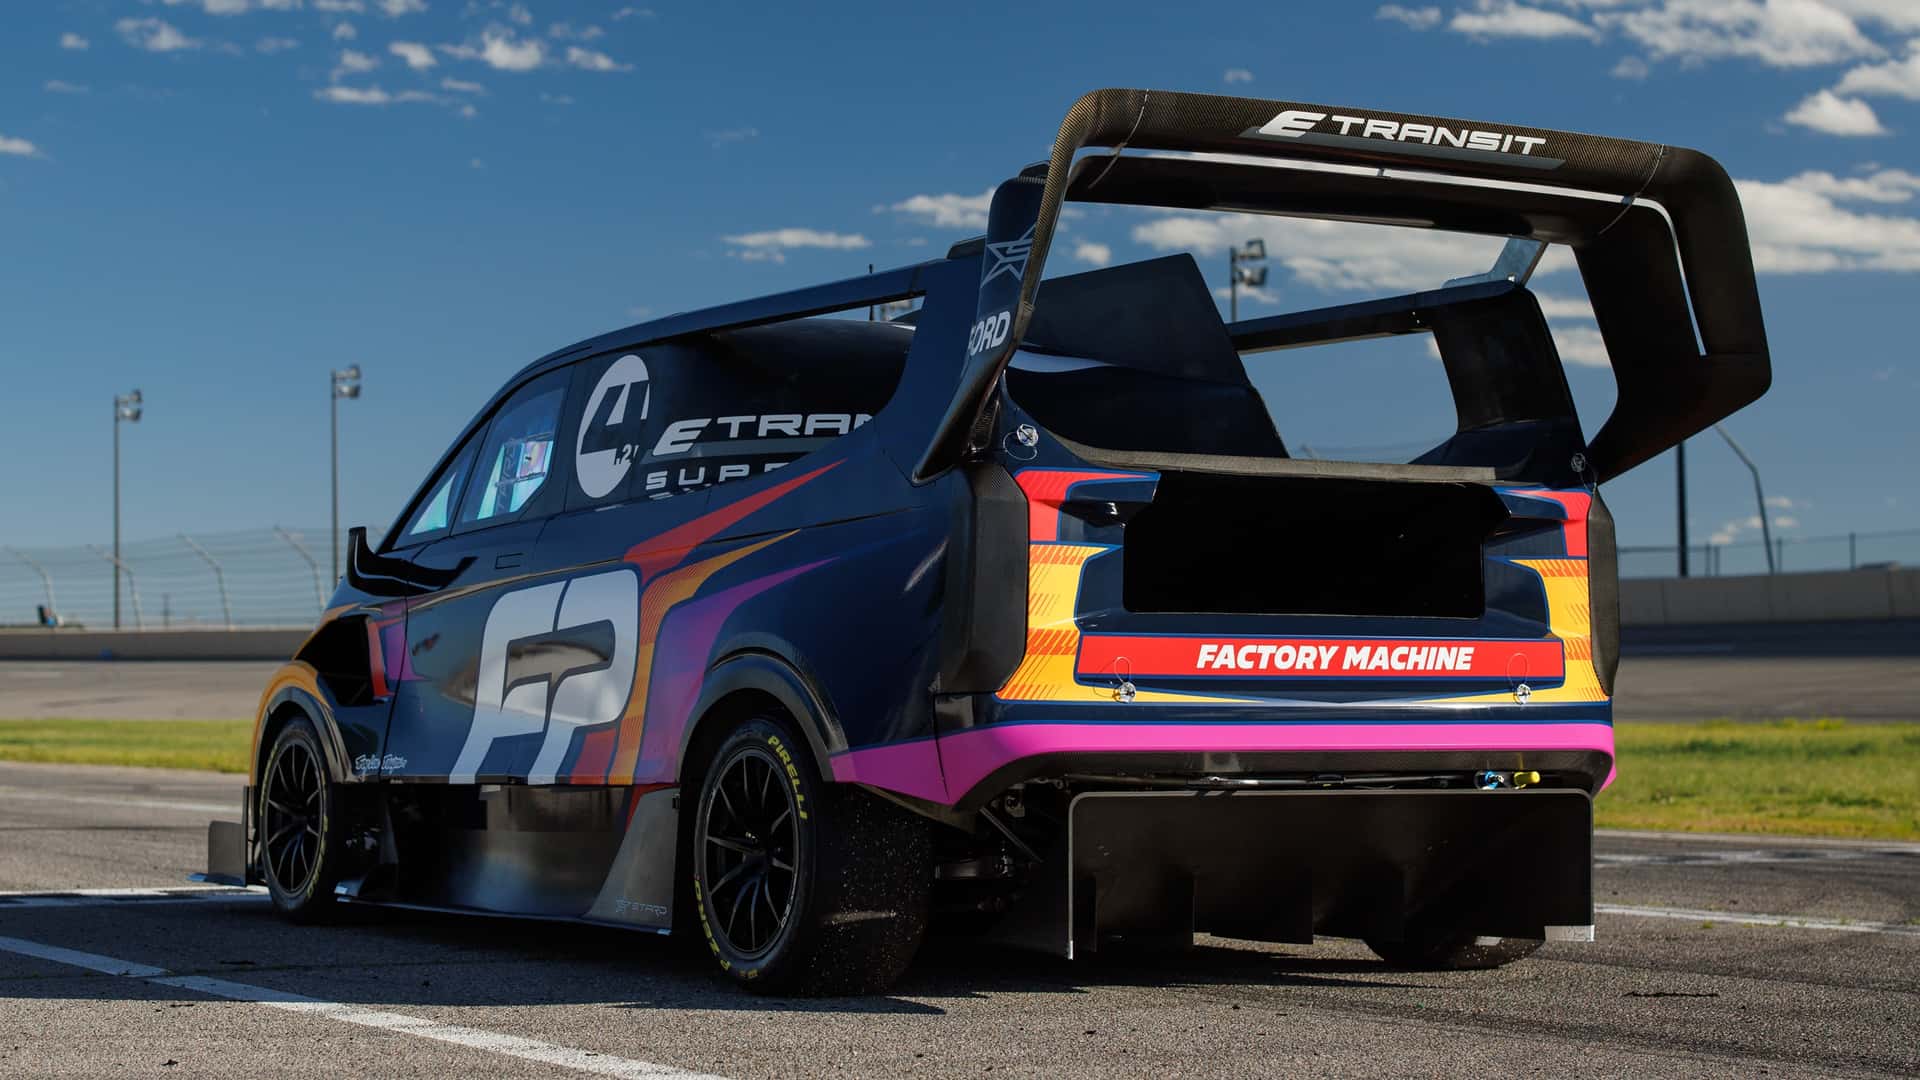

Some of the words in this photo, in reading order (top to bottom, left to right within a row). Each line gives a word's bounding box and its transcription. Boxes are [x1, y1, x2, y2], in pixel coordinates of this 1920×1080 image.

[1196, 644, 1340, 671] FACTORY
[1342, 645, 1475, 671] MACHINE
[767, 735, 808, 820] PIRELLI
